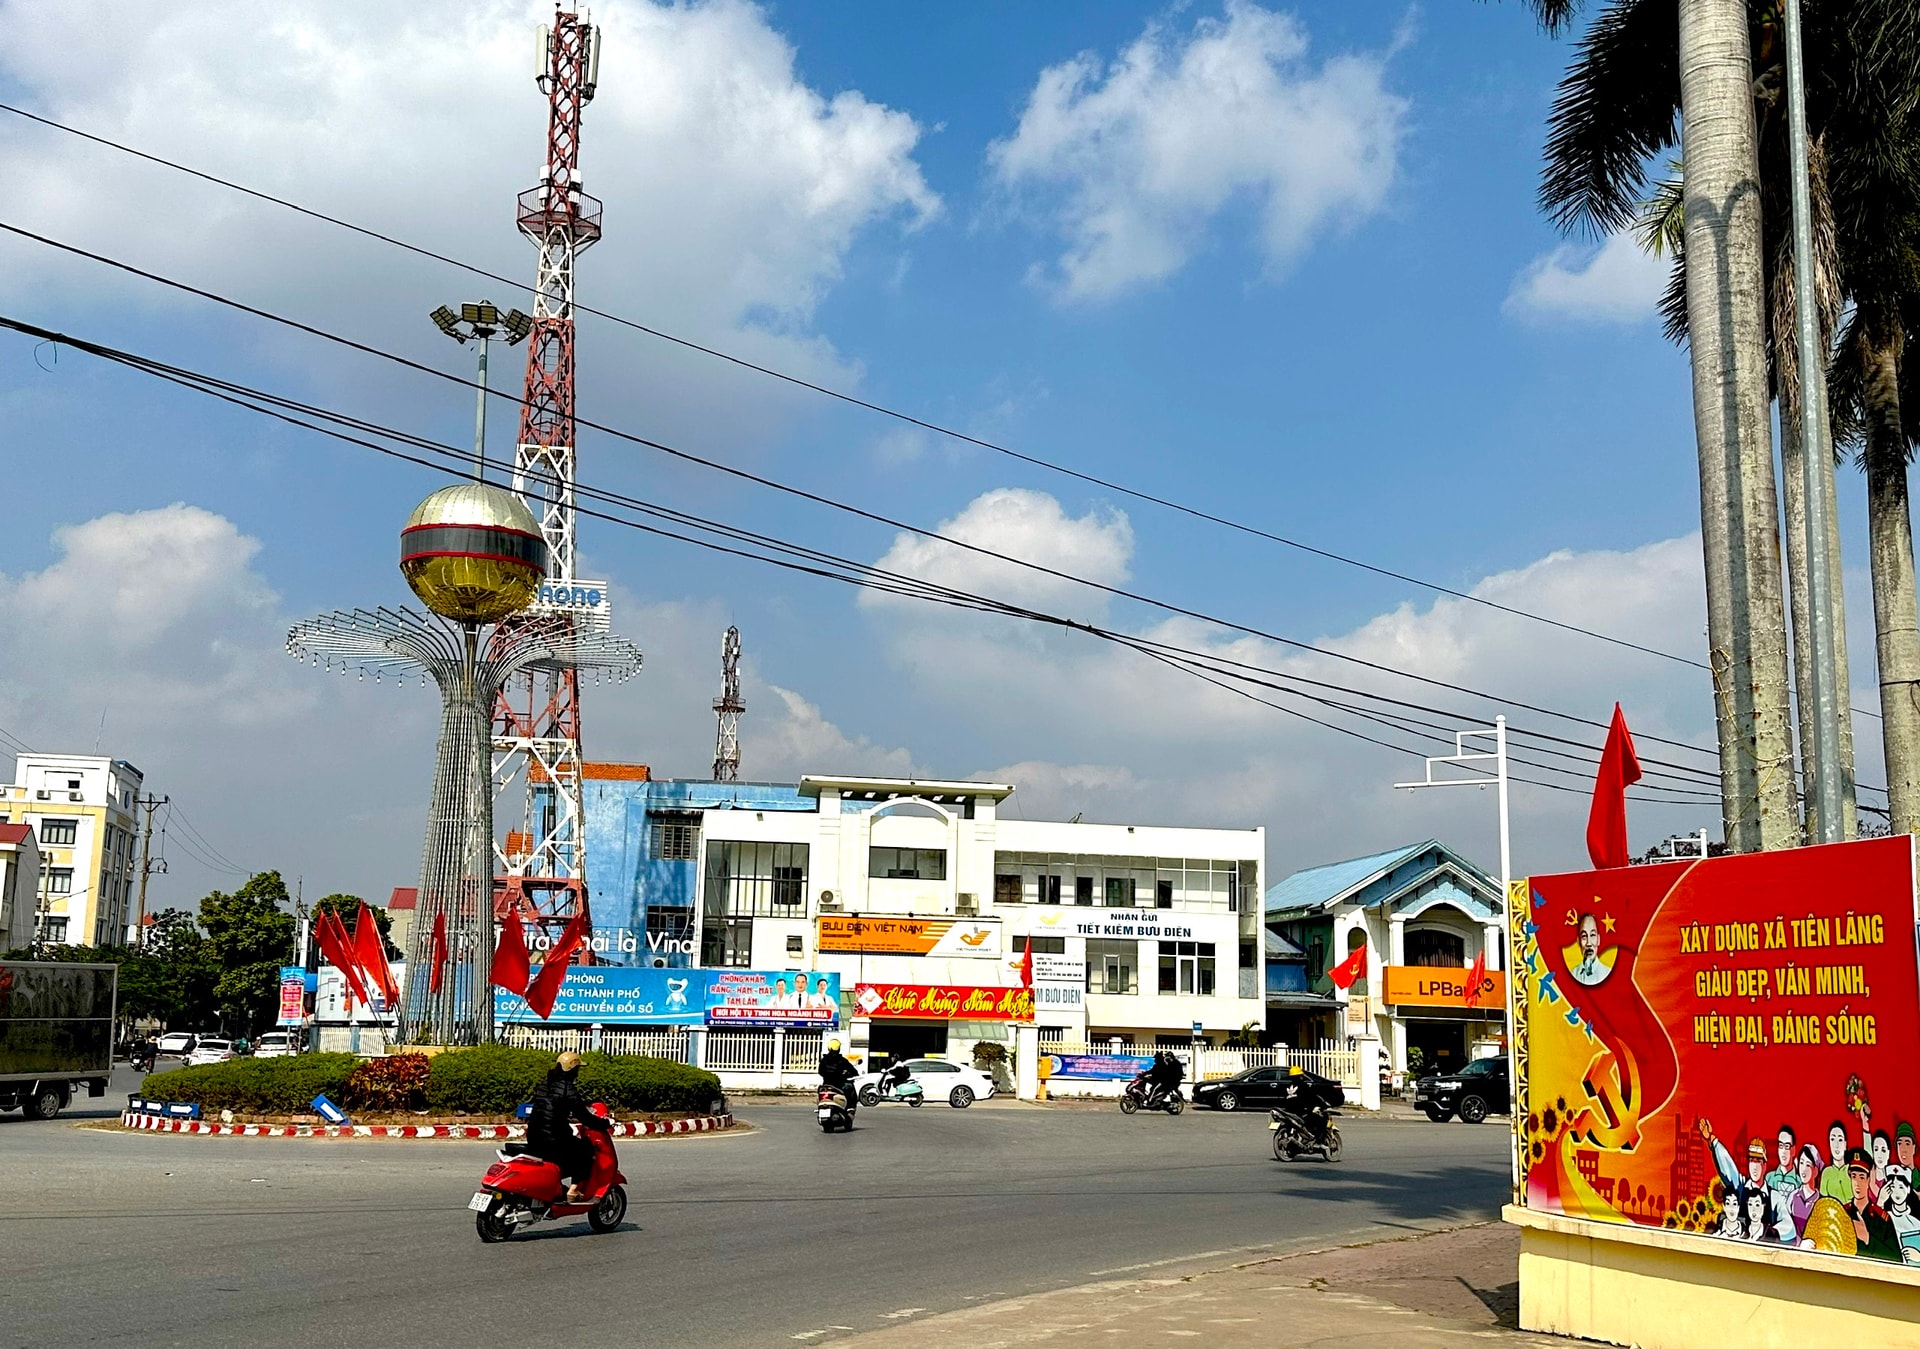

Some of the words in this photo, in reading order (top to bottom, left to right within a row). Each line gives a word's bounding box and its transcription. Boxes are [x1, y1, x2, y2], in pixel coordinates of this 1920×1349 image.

[822, 920, 844, 931] BƯU
[874, 922, 897, 934] VIỆT
[900, 924, 923, 934] NAM
[1077, 922, 1100, 934] TIẾT
[1104, 923, 1134, 937] KIỆM
[1137, 925, 1160, 936] BƯU
[1164, 926, 1191, 939] ĐIỆN
[1680, 921, 1710, 953] XÂY
[1714, 922, 1759, 957] DỰNG
[1763, 915, 1787, 949] XÃ
[1790, 913, 1830, 948] TIÊN
[1835, 910, 1884, 946] LÃNG
[618, 927, 637, 952] là
[565, 973, 604, 984] PHÒNG
[1695, 965, 1732, 997] GIÀU
[1736, 969, 1771, 1003] ĐẸP,
[1775, 962, 1810, 996] VĂN
[1815, 966, 1870, 998] MINH,
[577, 987, 614, 998] THÀNH
[617, 987, 641, 999] PHỐ
[1045, 987, 1061, 1004] BƯU
[1062, 986, 1081, 1007] ĐIỆN
[1418, 980, 1482, 998] LPBak
[569, 999, 614, 1013] CHUYỂN
[617, 1000, 635, 1013] ĐỔI
[638, 1001, 654, 1014] SỐ
[884, 986, 918, 1014] Chúc
[919, 986, 960, 1017] Mừng
[962, 987, 995, 1012] Năm
[1693, 1010, 1731, 1049] HIỆN
[1735, 1016, 1768, 1050] ĐẠI,
[1772, 1009, 1820, 1044] ĐÁNG
[1826, 1005, 1876, 1045] SỐNG
